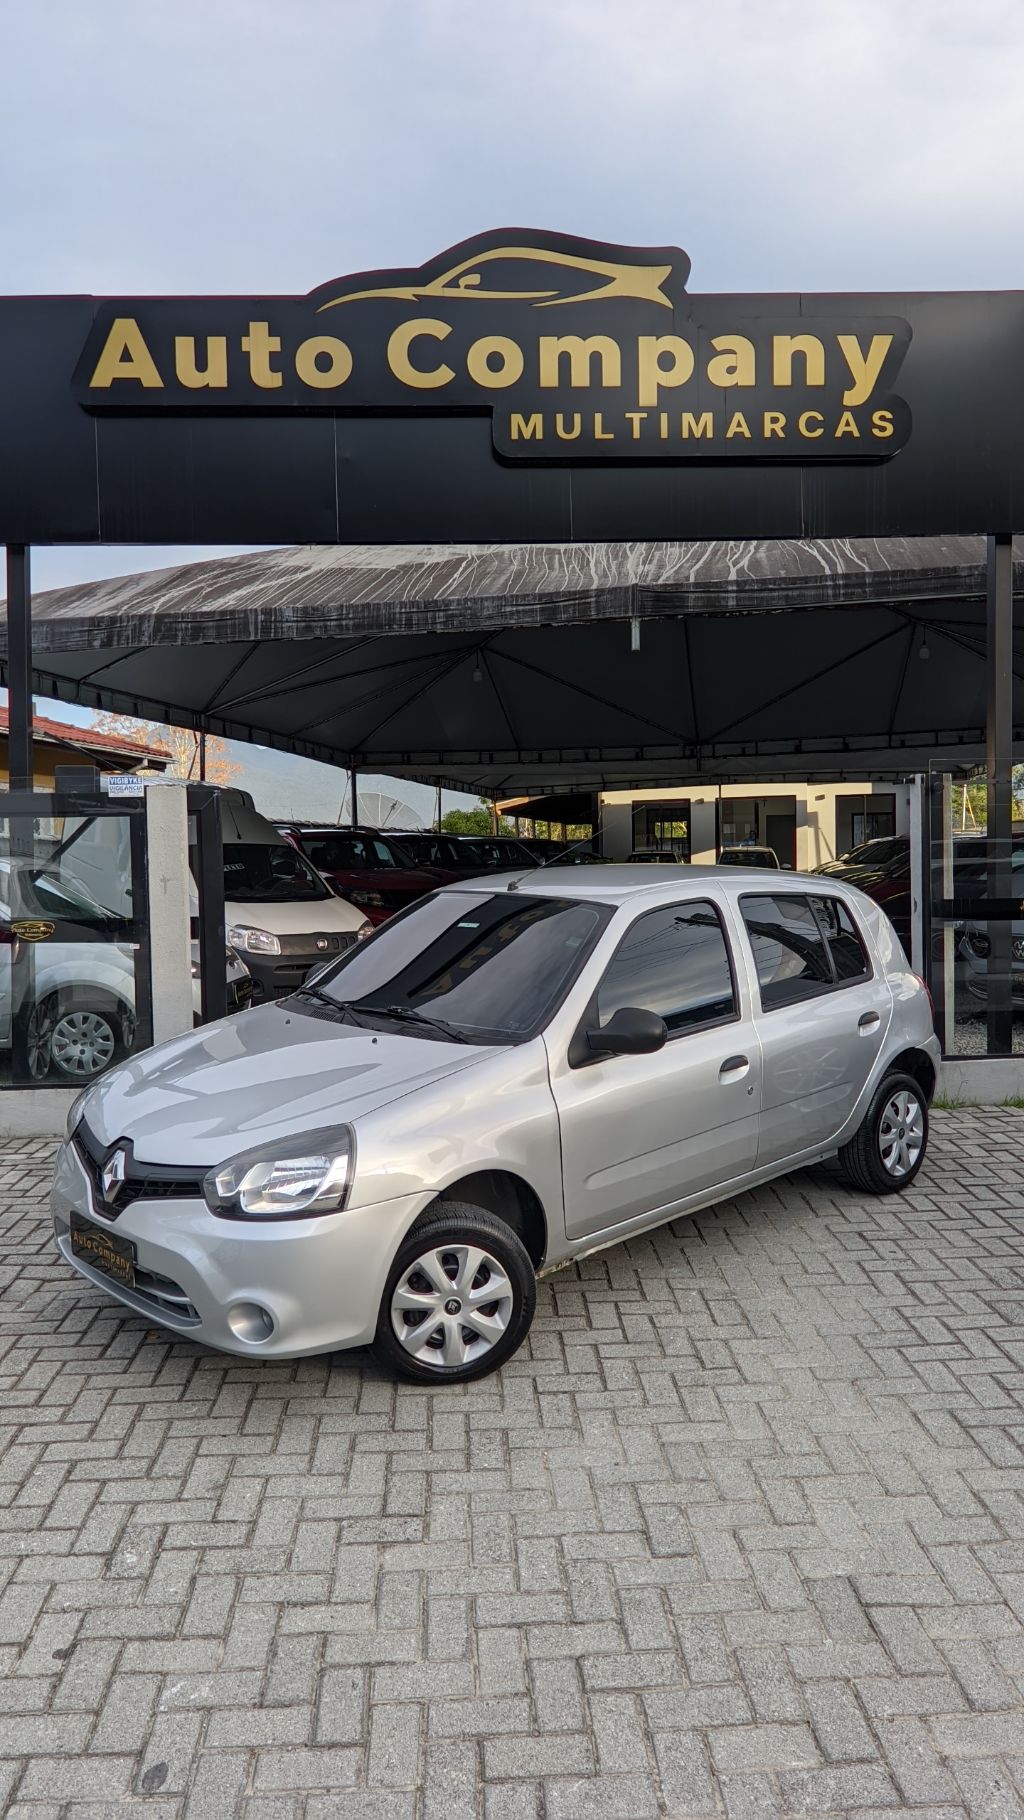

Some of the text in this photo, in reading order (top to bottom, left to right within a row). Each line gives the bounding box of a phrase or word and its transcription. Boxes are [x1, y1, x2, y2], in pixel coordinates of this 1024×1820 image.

[89, 318, 893, 407] Auto Company
[510, 410, 894, 440] MULTIMARCAS
